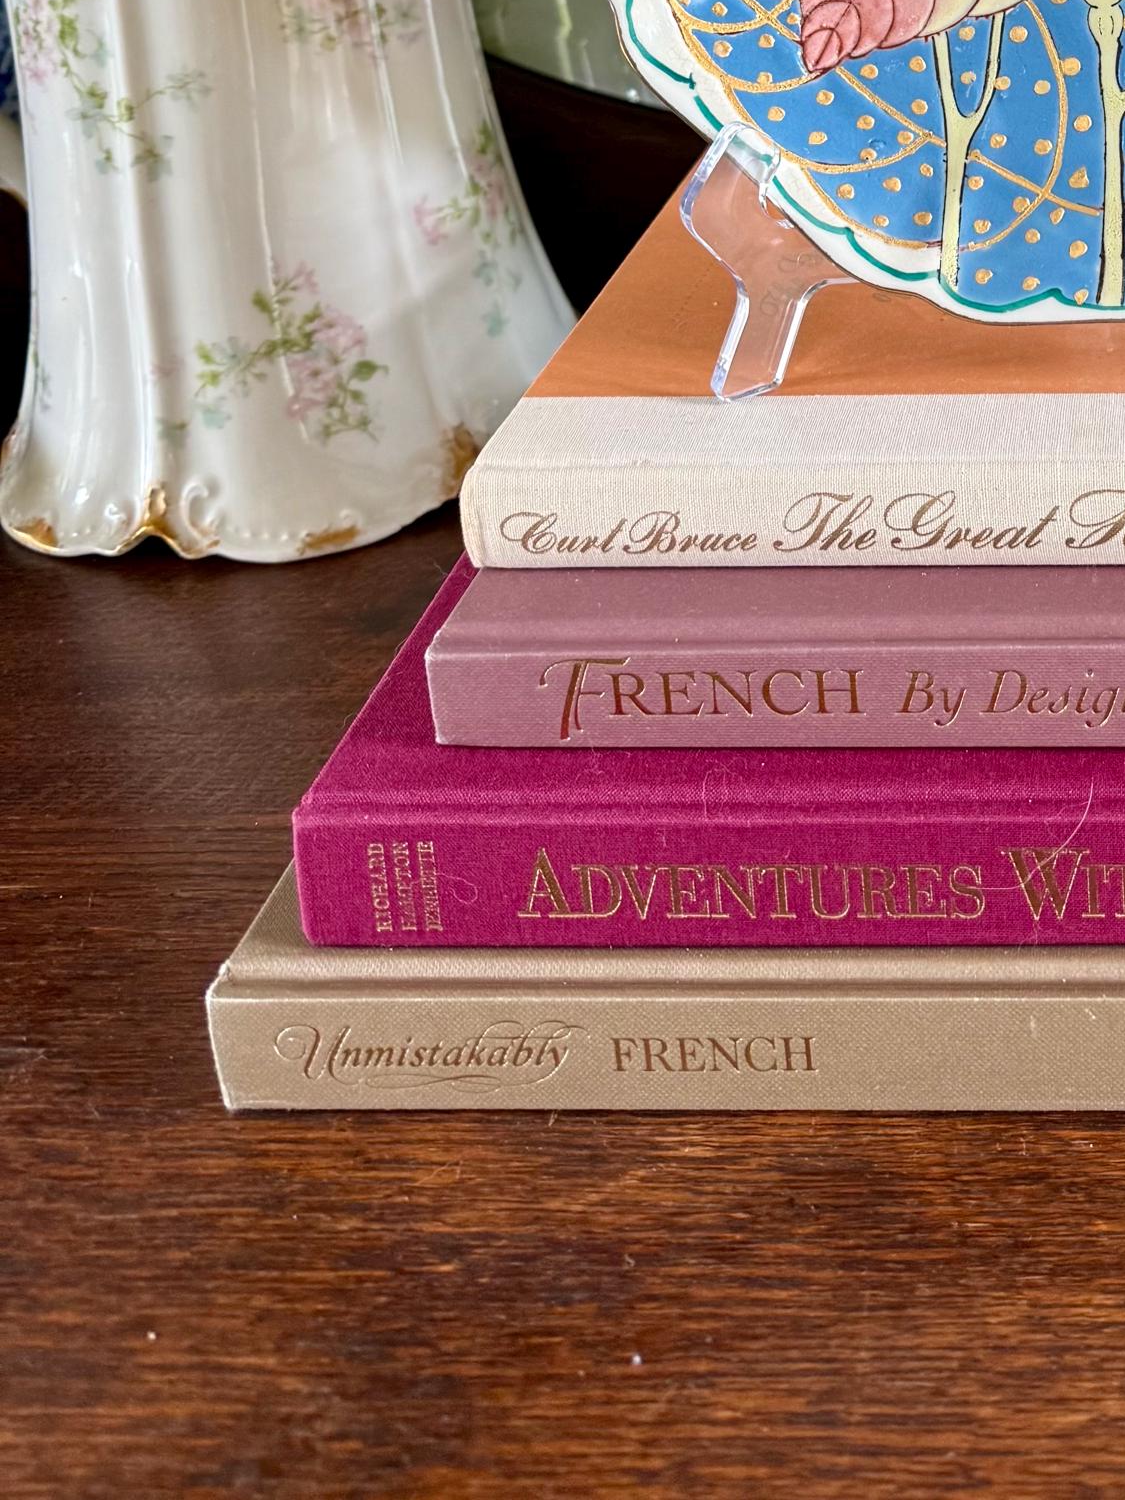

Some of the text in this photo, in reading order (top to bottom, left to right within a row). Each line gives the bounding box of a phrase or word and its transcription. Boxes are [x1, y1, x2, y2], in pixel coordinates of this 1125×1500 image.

[622, 510, 758, 554] Bruce
[773, 491, 877, 552] The
[882, 489, 1060, 552] Great
[538, 656, 867, 741] FRENCH
[898, 669, 966, 728] By
[366, 842, 394, 933] RICHARD
[516, 847, 987, 919] ADVENTURES
[274, 1019, 818, 1094] Unmistakably FRENCH
